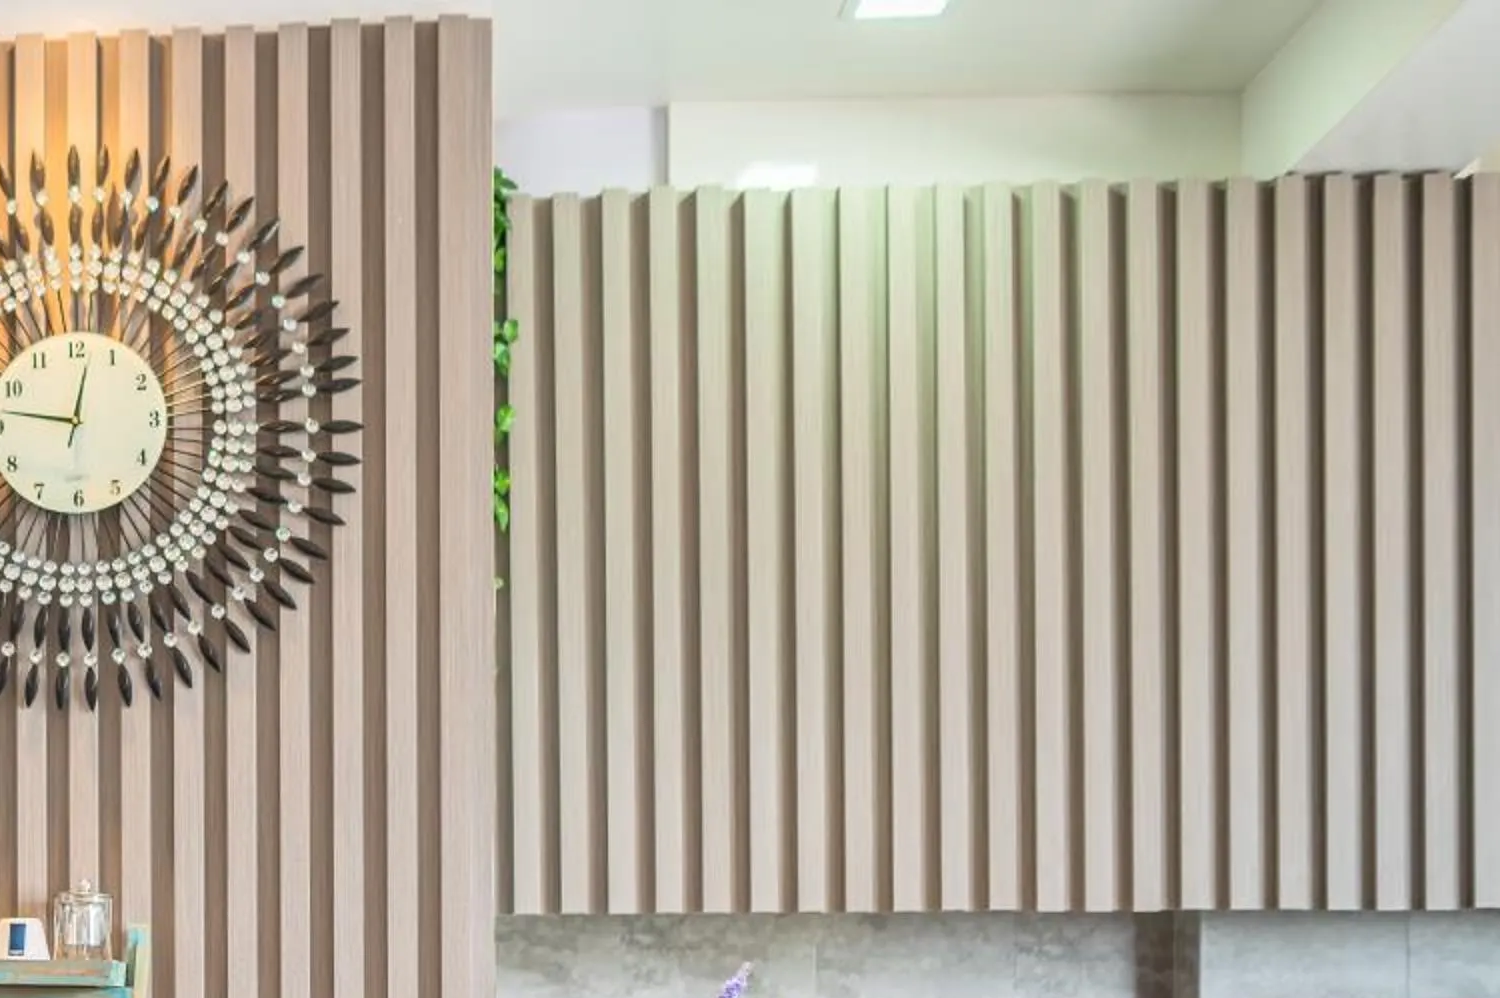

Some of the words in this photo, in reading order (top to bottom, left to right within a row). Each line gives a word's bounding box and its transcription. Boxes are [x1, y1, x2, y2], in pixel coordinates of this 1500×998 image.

[68, 341, 85, 358] 12
[32, 352, 46, 369] 11
[5, 381, 23, 398] 10
[136, 374, 147, 391] 2
[149, 411, 160, 428] 3
[7, 455, 17, 473] 8
[136, 449, 147, 465] 4
[33, 483, 45, 500] 7
[109, 480, 121, 495] 5
[73, 490, 84, 507] 6
